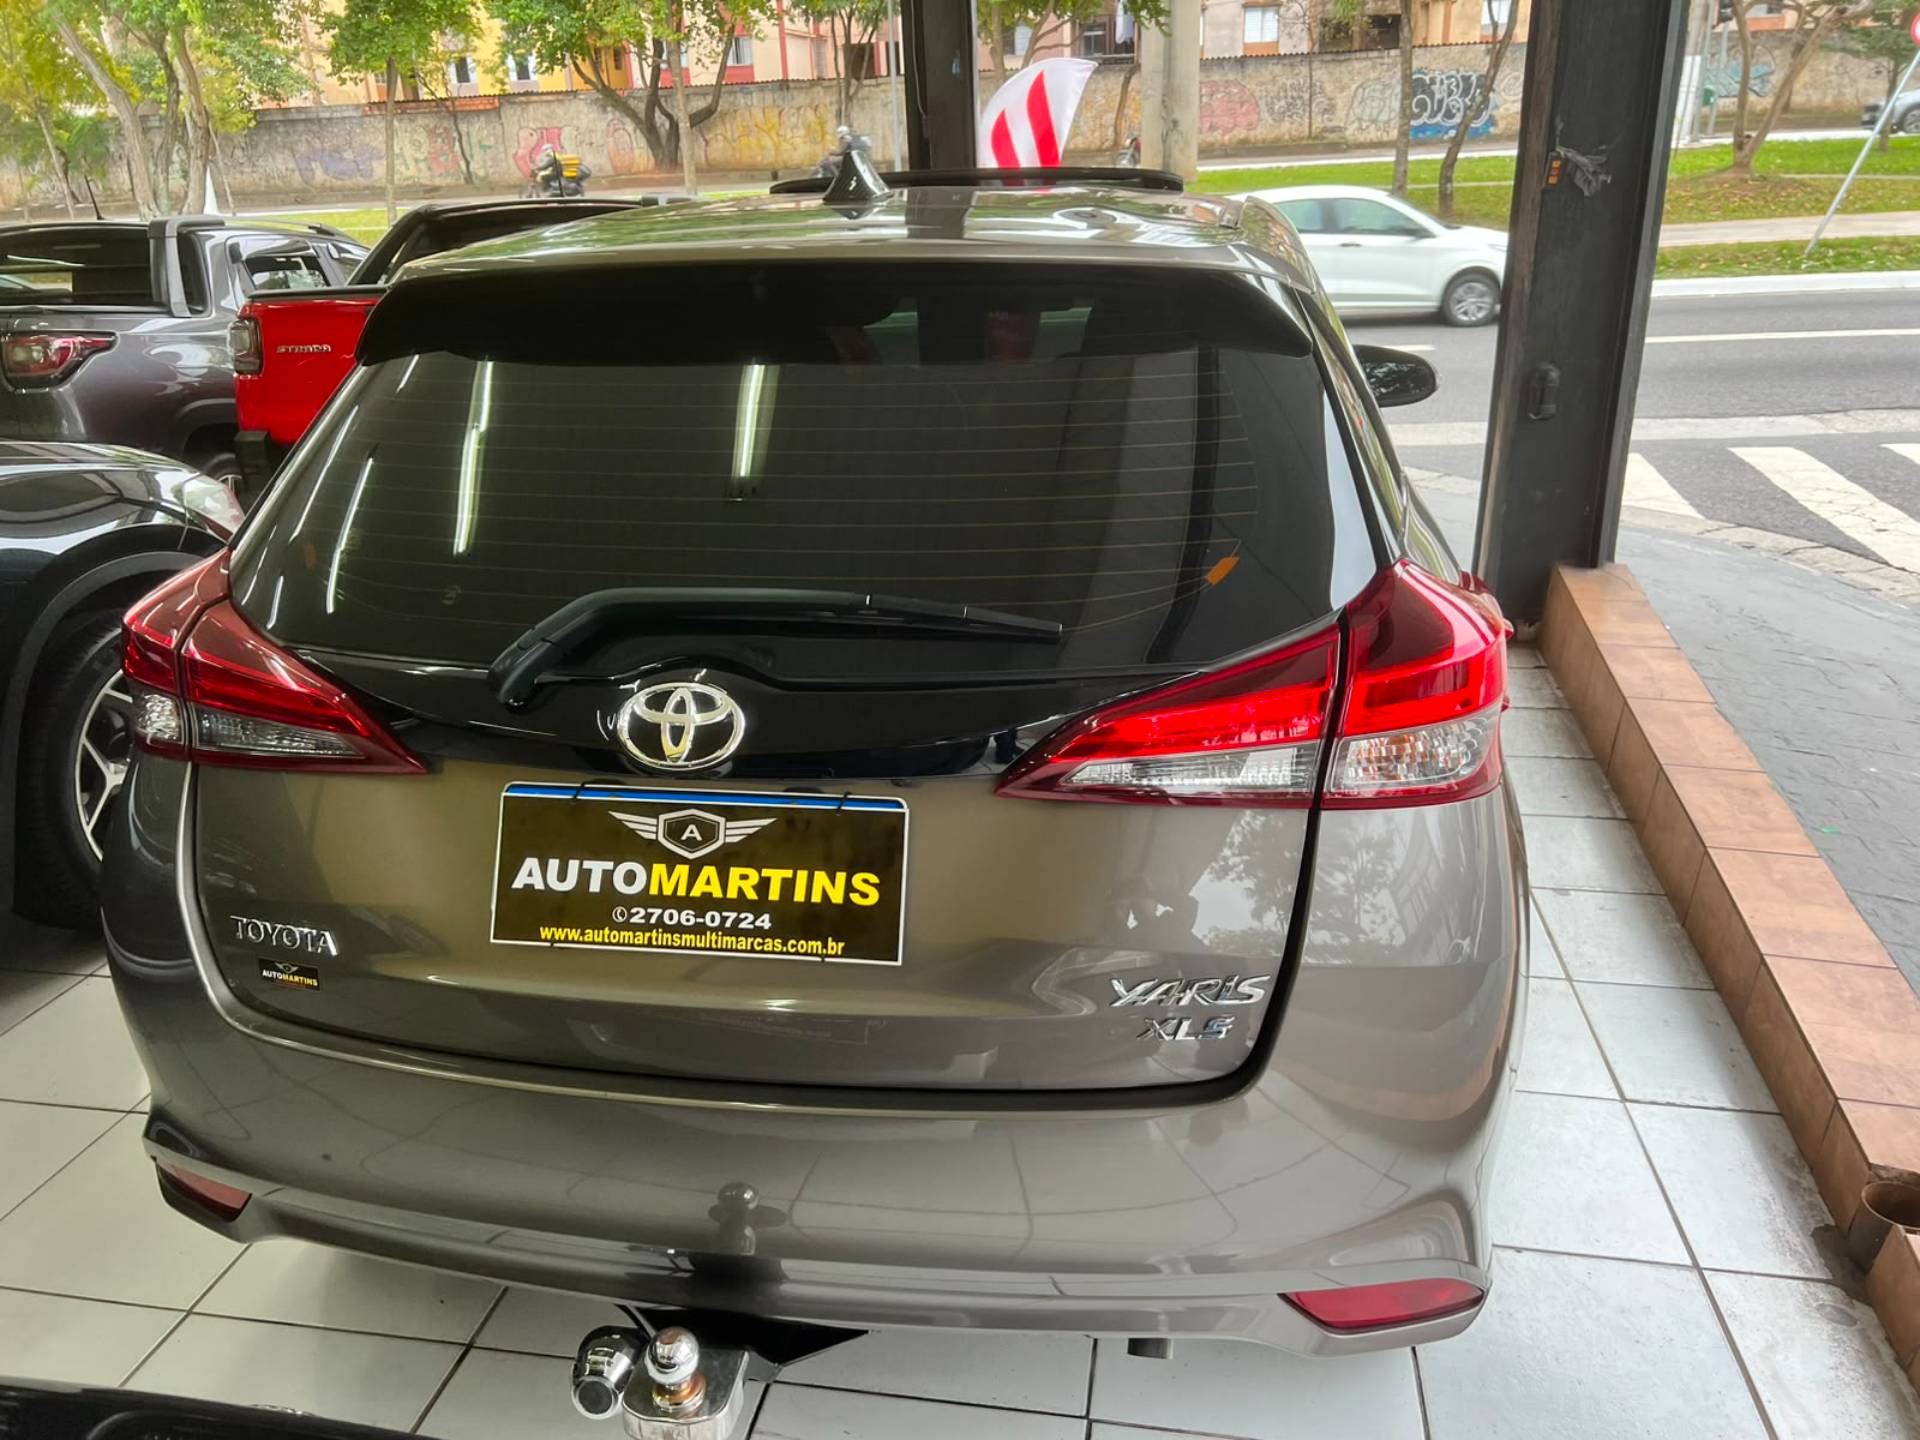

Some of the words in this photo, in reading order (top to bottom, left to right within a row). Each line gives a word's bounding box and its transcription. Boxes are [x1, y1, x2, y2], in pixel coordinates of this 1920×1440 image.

[680, 824, 703, 842] A
[511, 857, 881, 906] AUTOMARTINS
[629, 907, 772, 930] 2706-0724
[230, 915, 338, 956] TOYOTA
[539, 926, 846, 955] www.automartinsmultimarcas.com.br
[262, 969, 318, 986] AUTOMARTINS
[1110, 975, 1271, 1007] YARIS
